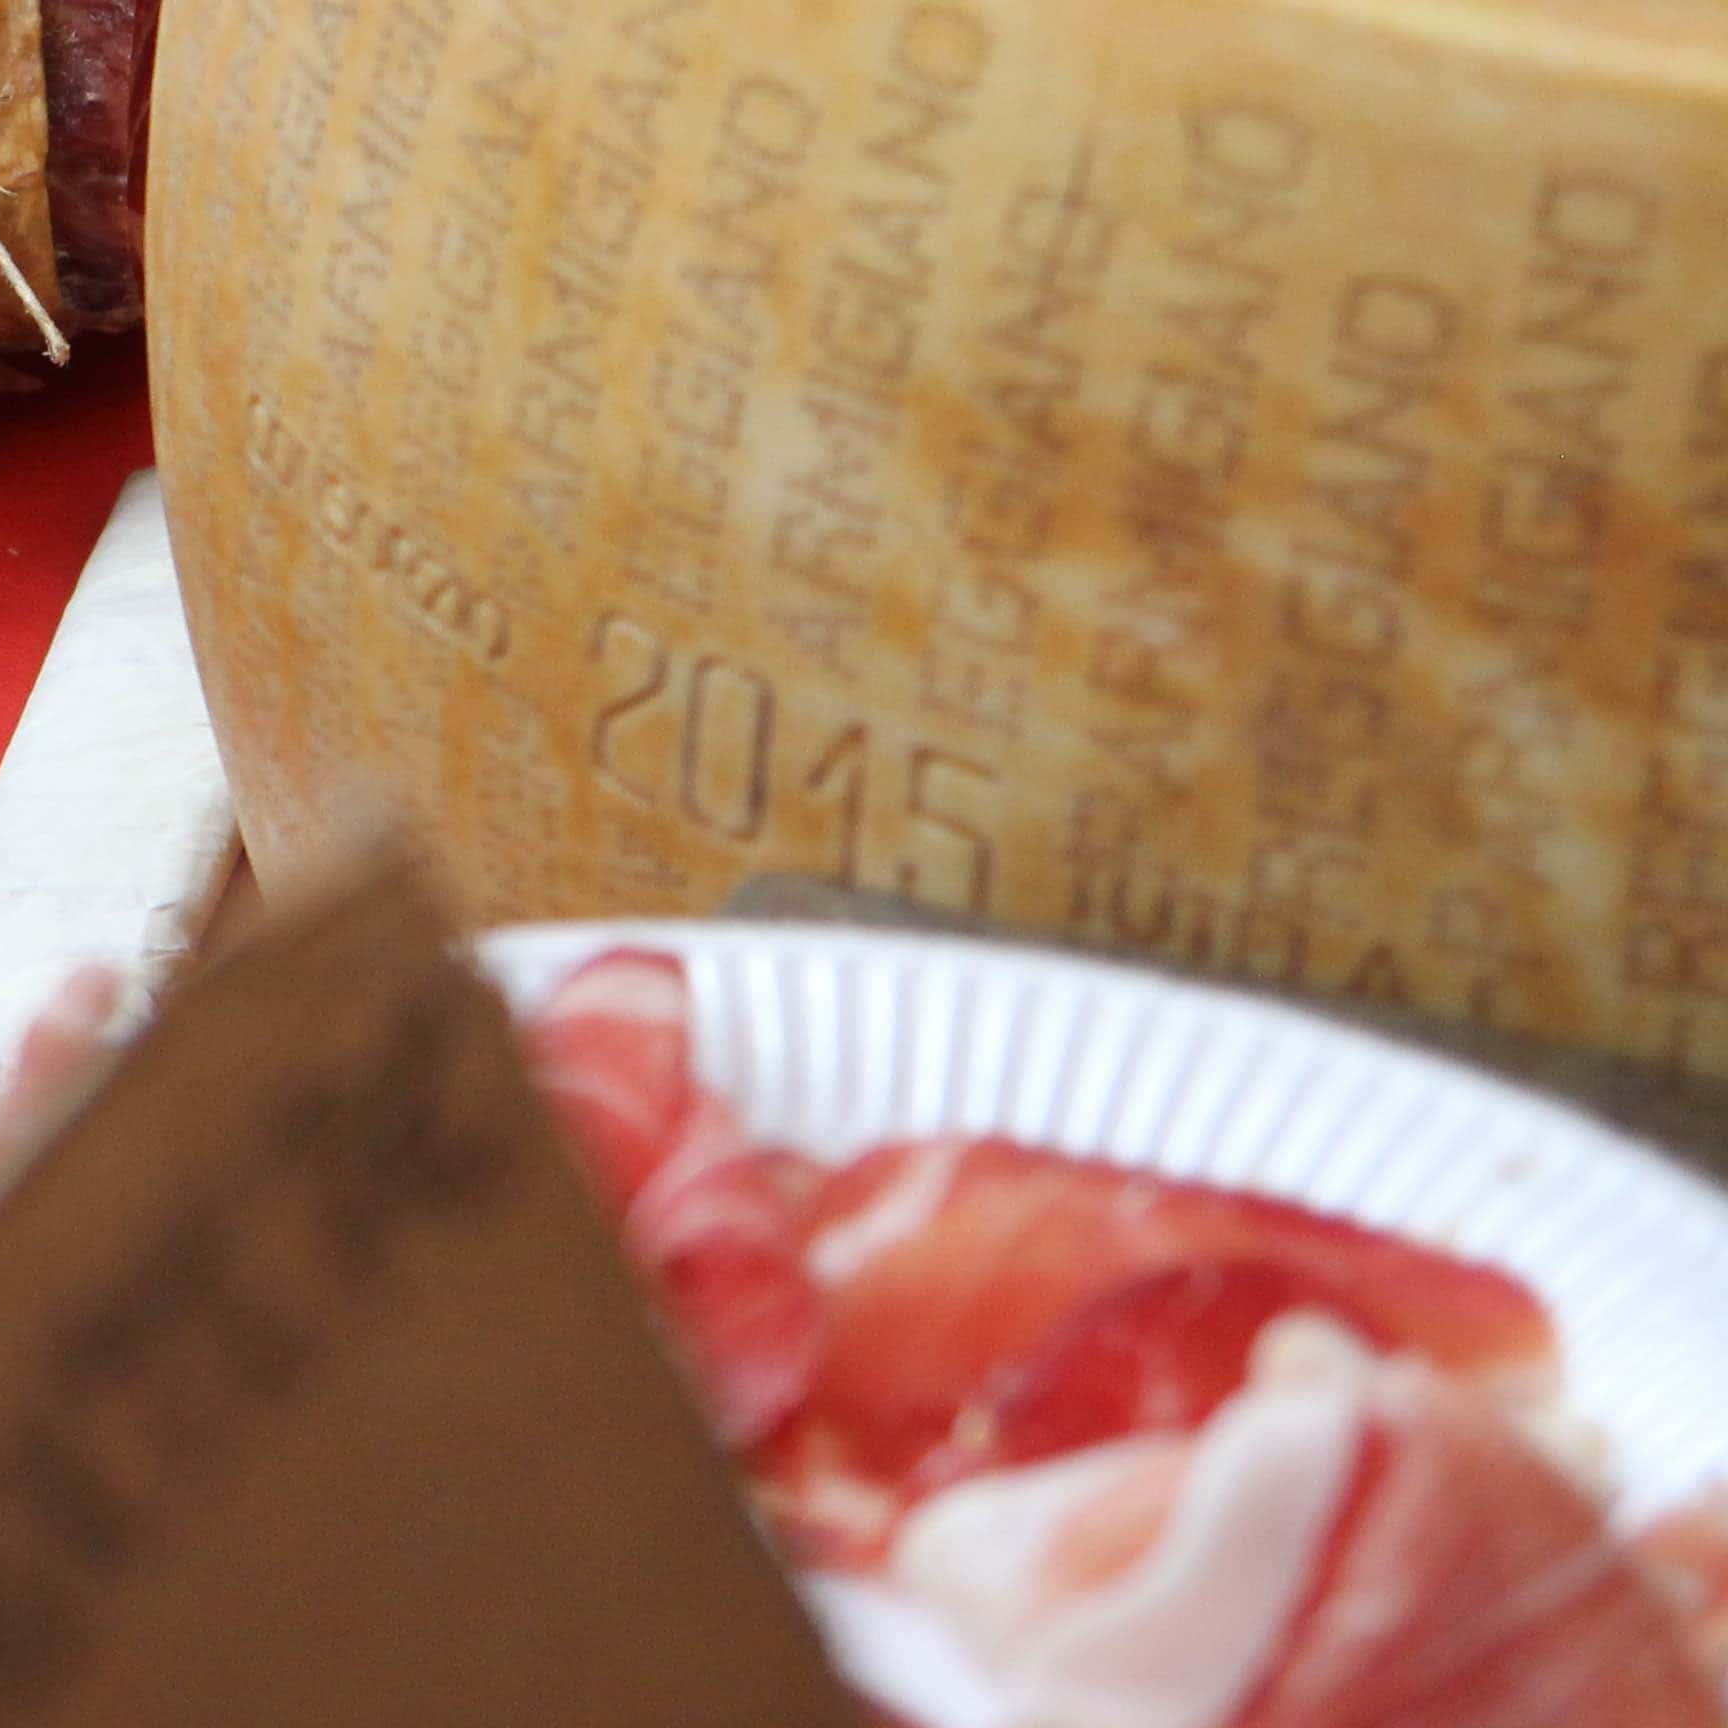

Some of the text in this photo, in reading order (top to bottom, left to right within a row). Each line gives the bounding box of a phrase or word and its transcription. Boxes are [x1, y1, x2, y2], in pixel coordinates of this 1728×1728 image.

[622, 75, 813, 610] EGGIANO
[766, 0, 987, 677] ARMIGIANO
[919, 182, 1111, 735] EGGIANO
[592, 608, 996, 917] 2015
